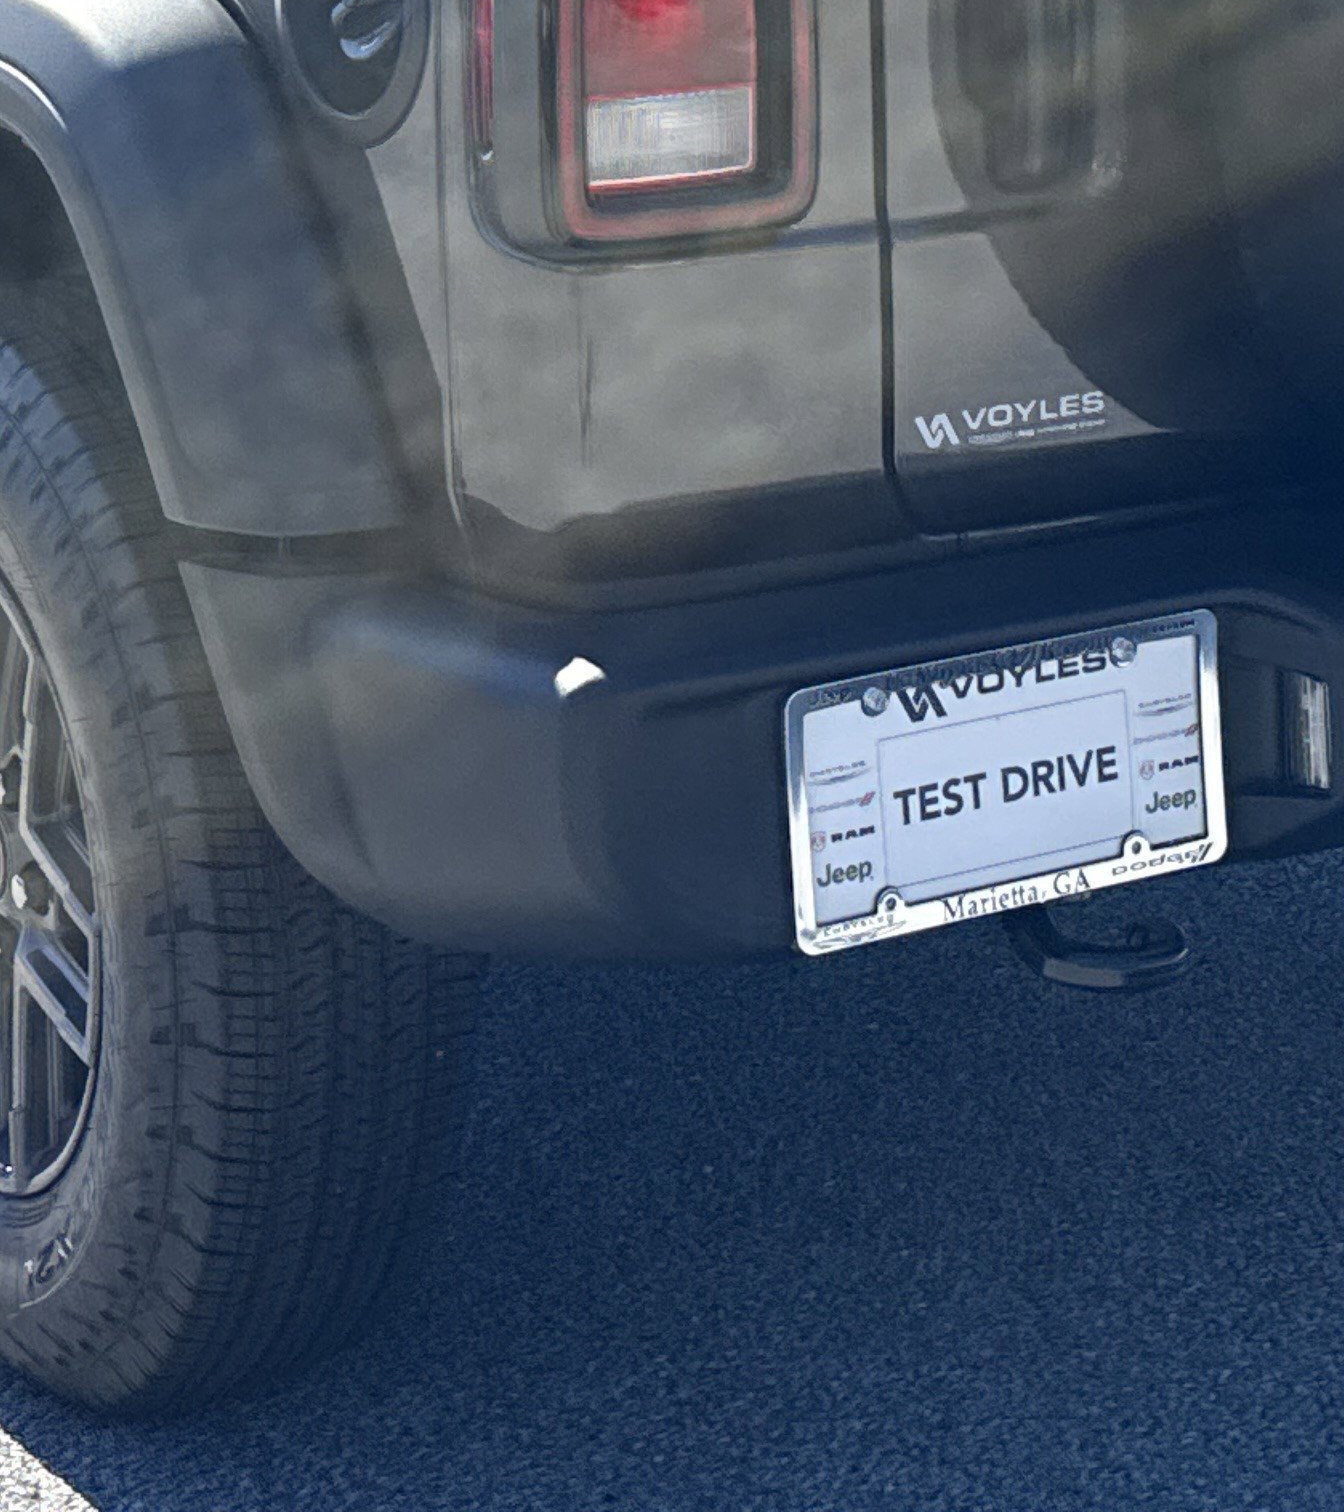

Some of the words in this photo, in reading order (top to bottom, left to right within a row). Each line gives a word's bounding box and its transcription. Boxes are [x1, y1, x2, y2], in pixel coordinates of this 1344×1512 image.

[961, 390, 1106, 430] VOYLES
[950, 651, 1107, 699] VOYLES
[1158, 755, 1199, 773] RAM
[893, 771, 987, 826] TEST
[1000, 745, 1119, 804] DRIVE
[1144, 789, 1197, 815] Jeep
[830, 825, 875, 843] RAM
[816, 860, 873, 888] Jeep
[942, 885, 1047, 922] Marietta,
[1053, 868, 1091, 896] GA
